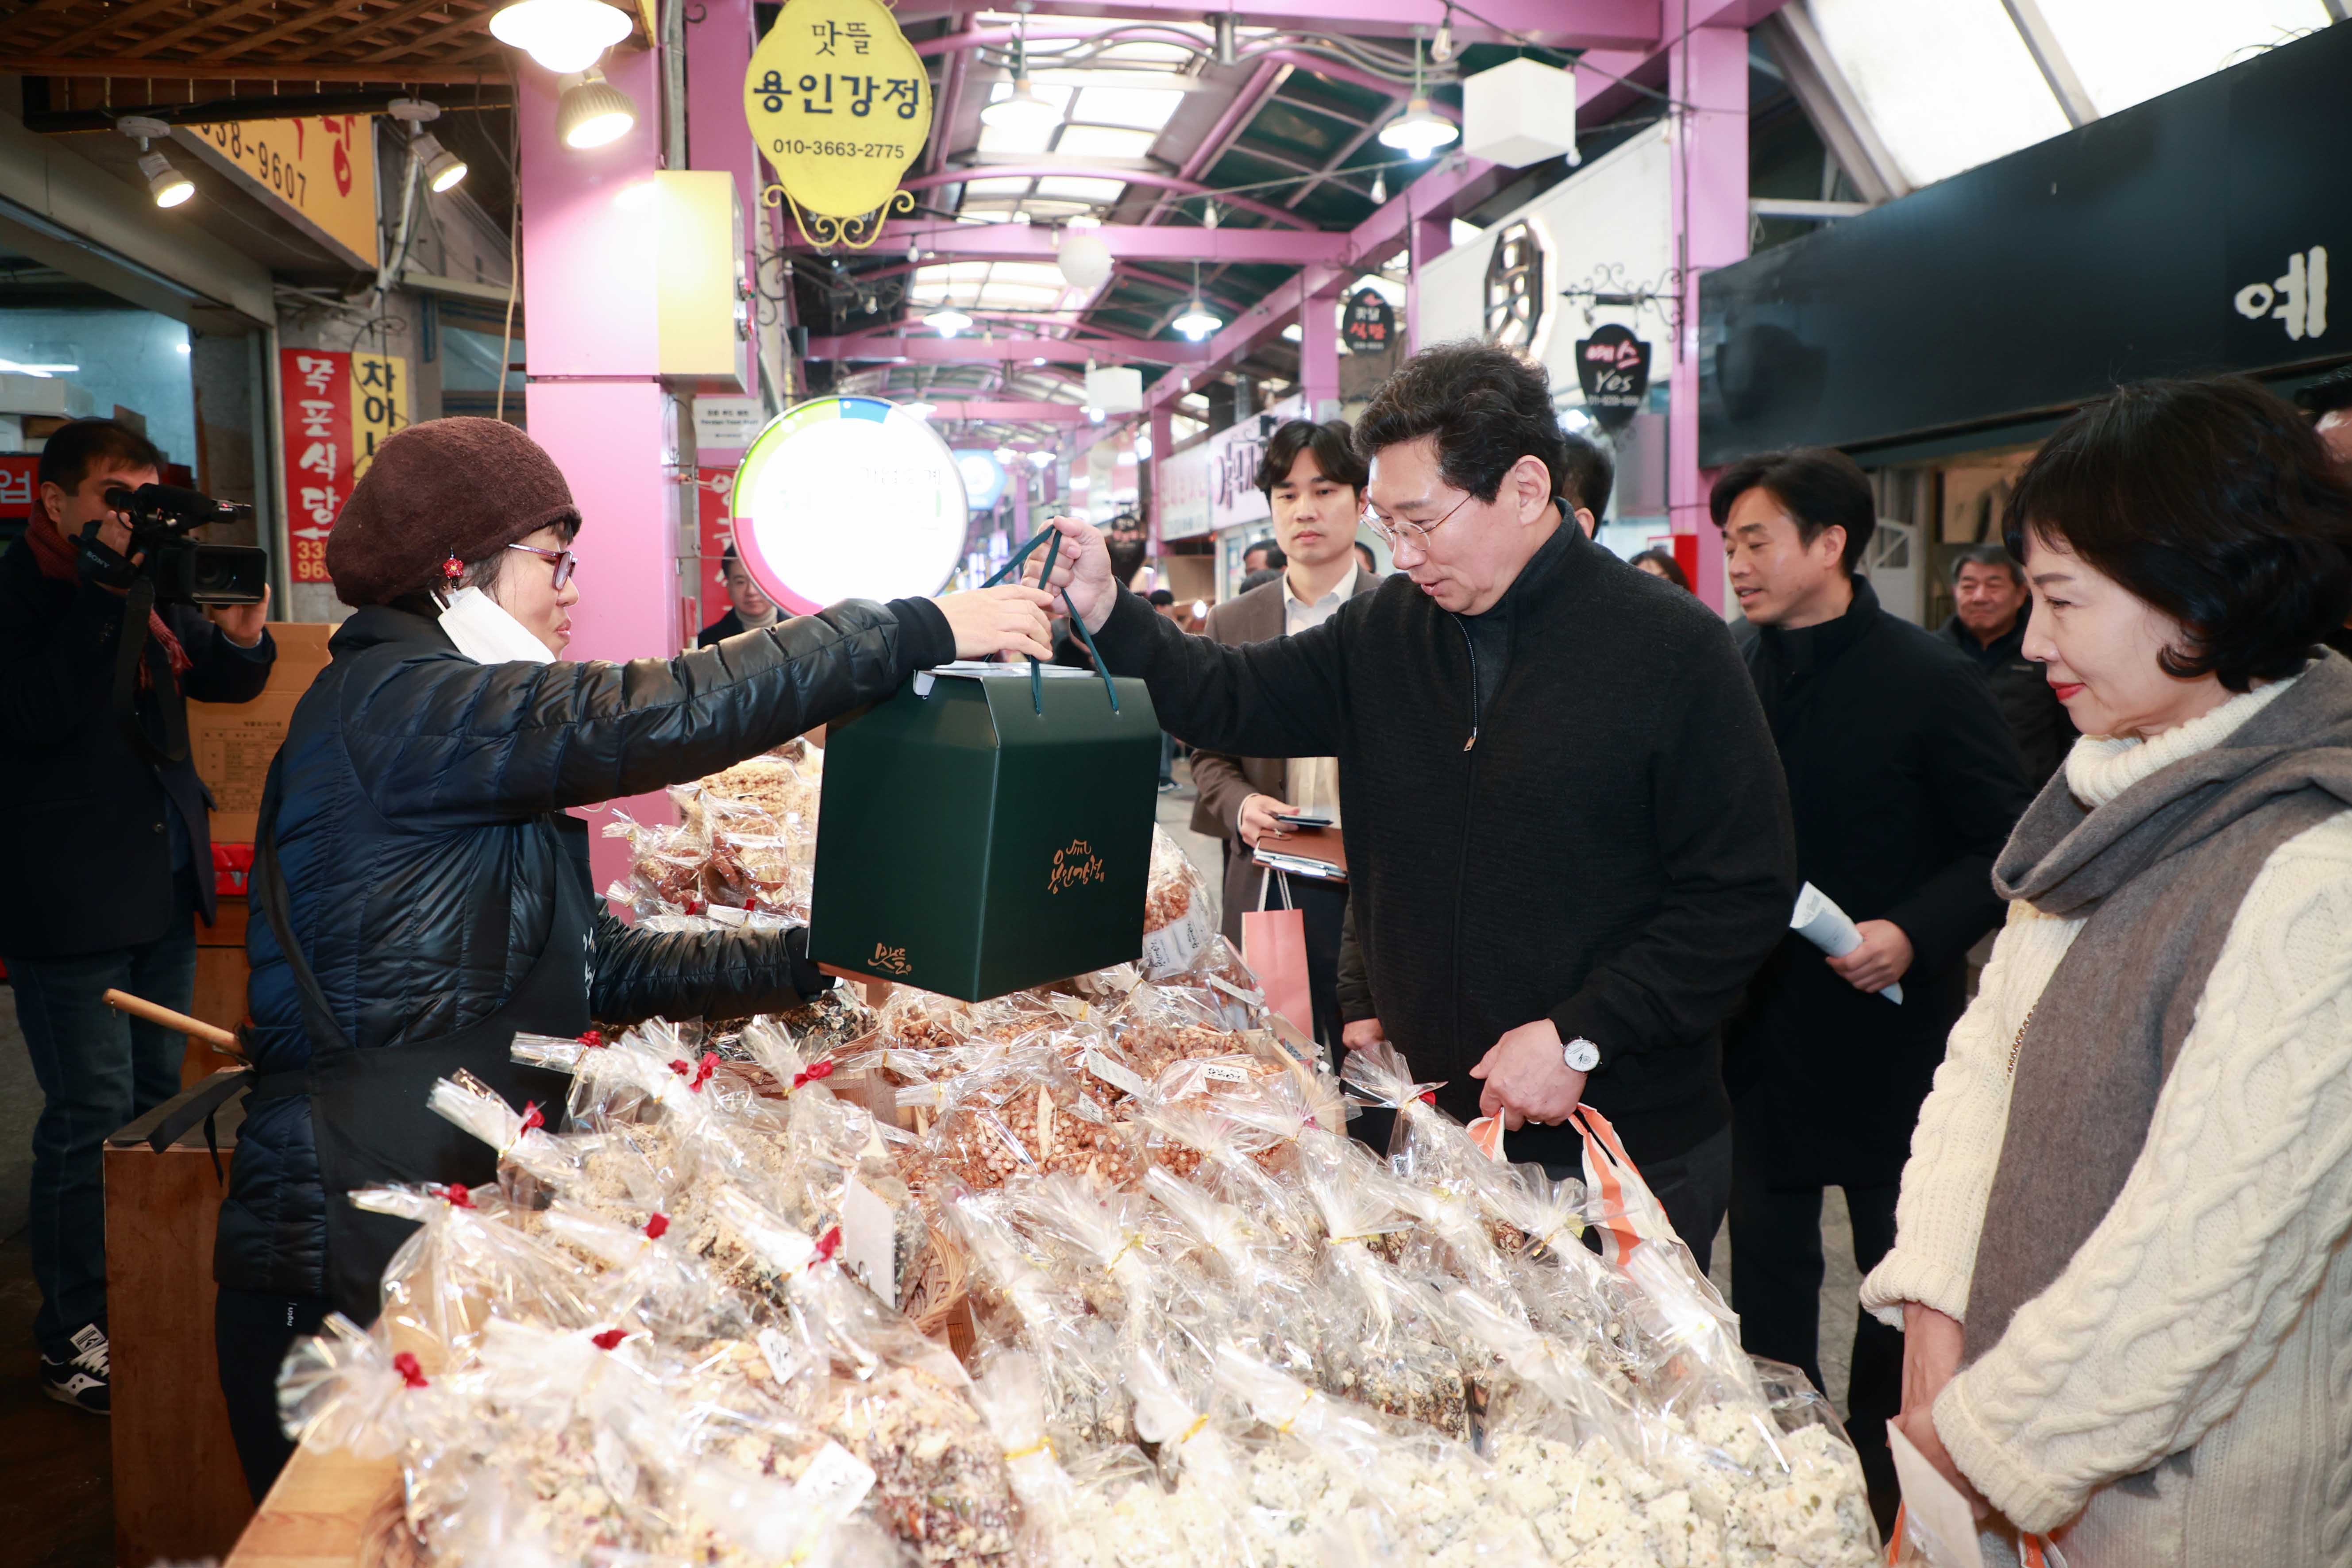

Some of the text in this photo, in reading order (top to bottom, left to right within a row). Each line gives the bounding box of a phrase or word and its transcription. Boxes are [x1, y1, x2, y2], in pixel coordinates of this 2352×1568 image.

[812, 20, 871, 56] 맛뜰
[754, 69, 919, 119] 용인강정
[774, 139, 905, 159] 010-3663-2775
[2234, 245, 2328, 341] 예
[1595, 369, 1634, 393] Yes
[296, 355, 341, 524] 목포식당
[86, 551, 110, 569] SONY
